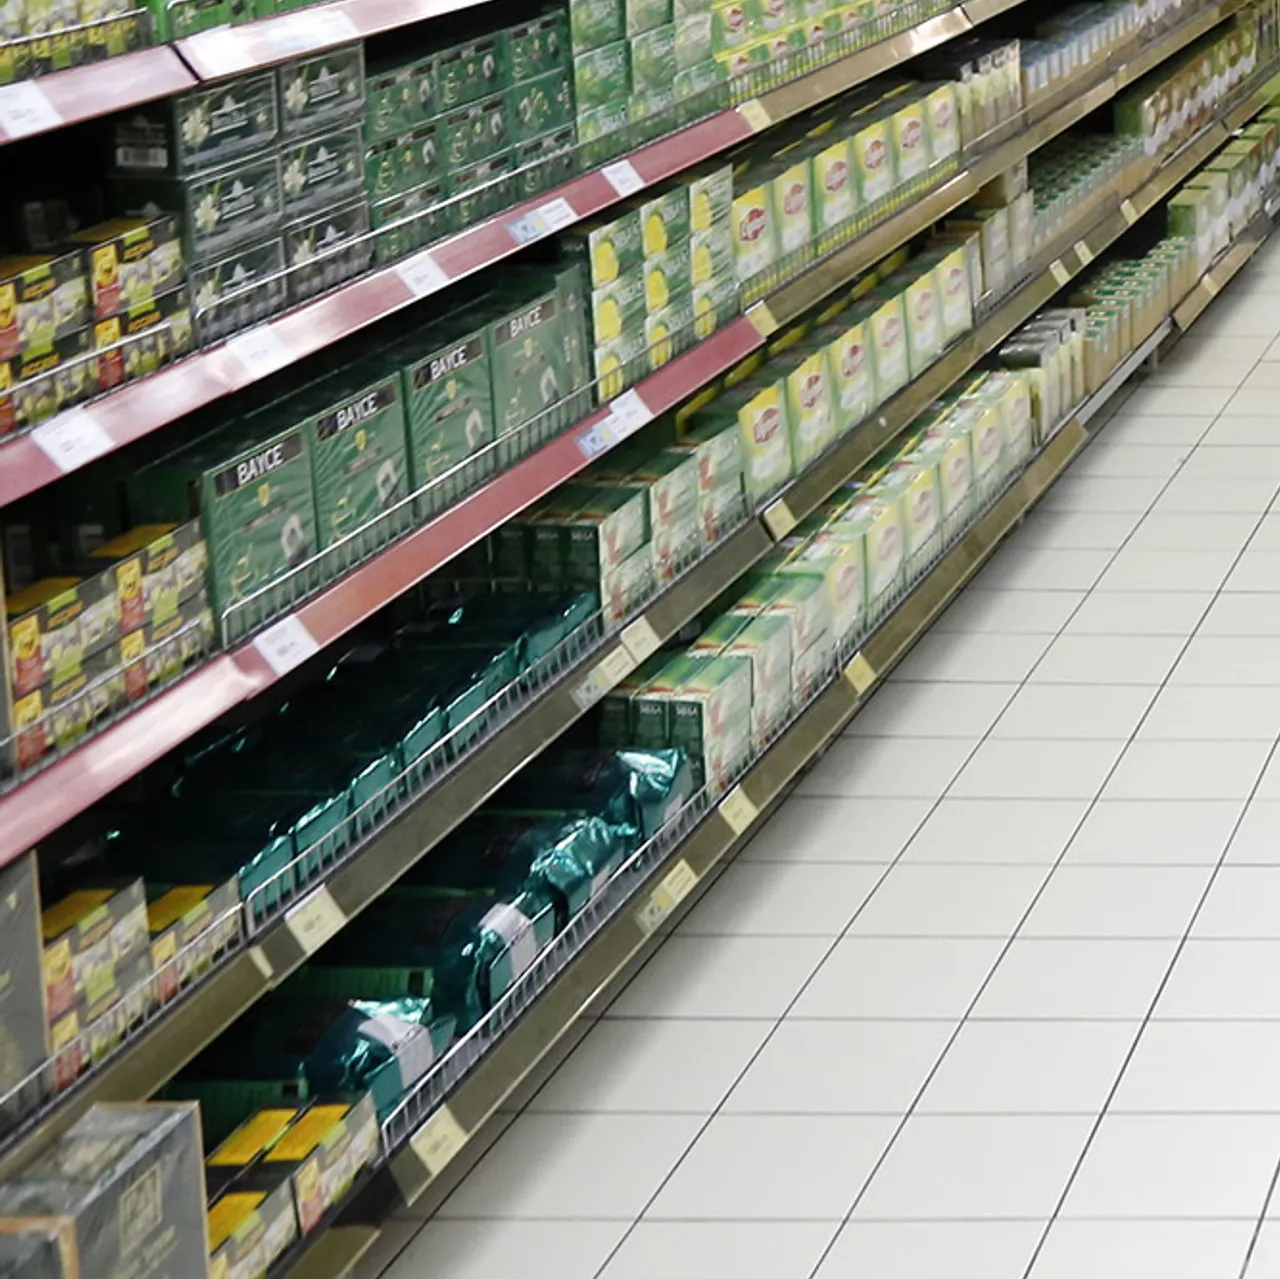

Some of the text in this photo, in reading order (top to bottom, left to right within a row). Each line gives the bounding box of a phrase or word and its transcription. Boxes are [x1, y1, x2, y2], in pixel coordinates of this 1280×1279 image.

[511, 305, 543, 339] BAYCE
[430, 345, 468, 379] BAYCE
[337, 391, 378, 432] BAYCE
[237, 444, 283, 487] BAYCE
